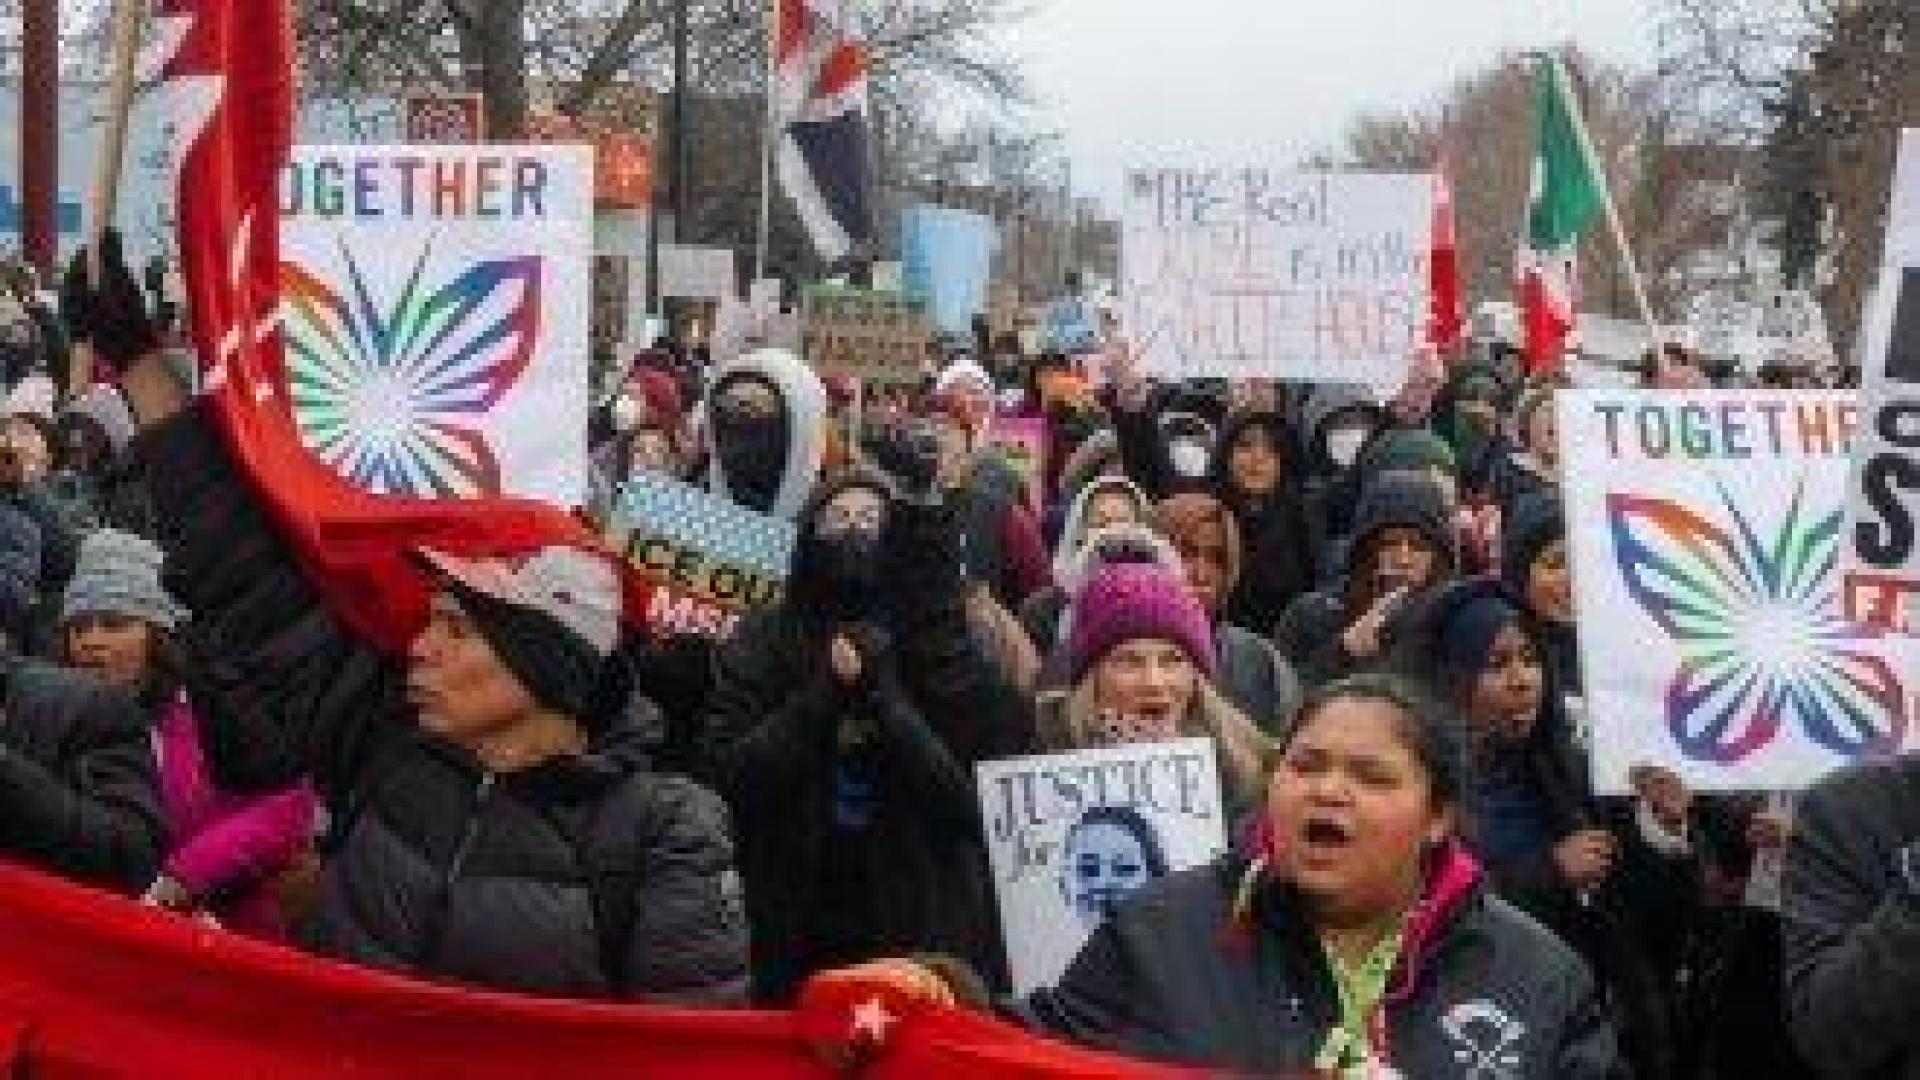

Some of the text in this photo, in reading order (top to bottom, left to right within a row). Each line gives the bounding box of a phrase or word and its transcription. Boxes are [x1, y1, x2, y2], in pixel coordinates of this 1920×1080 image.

[281, 156, 547, 215] OGETHER
[1594, 402, 1858, 458] TOGETHE
[624, 529, 778, 604] ICE OU
[993, 754, 1211, 843] JUSTICE
